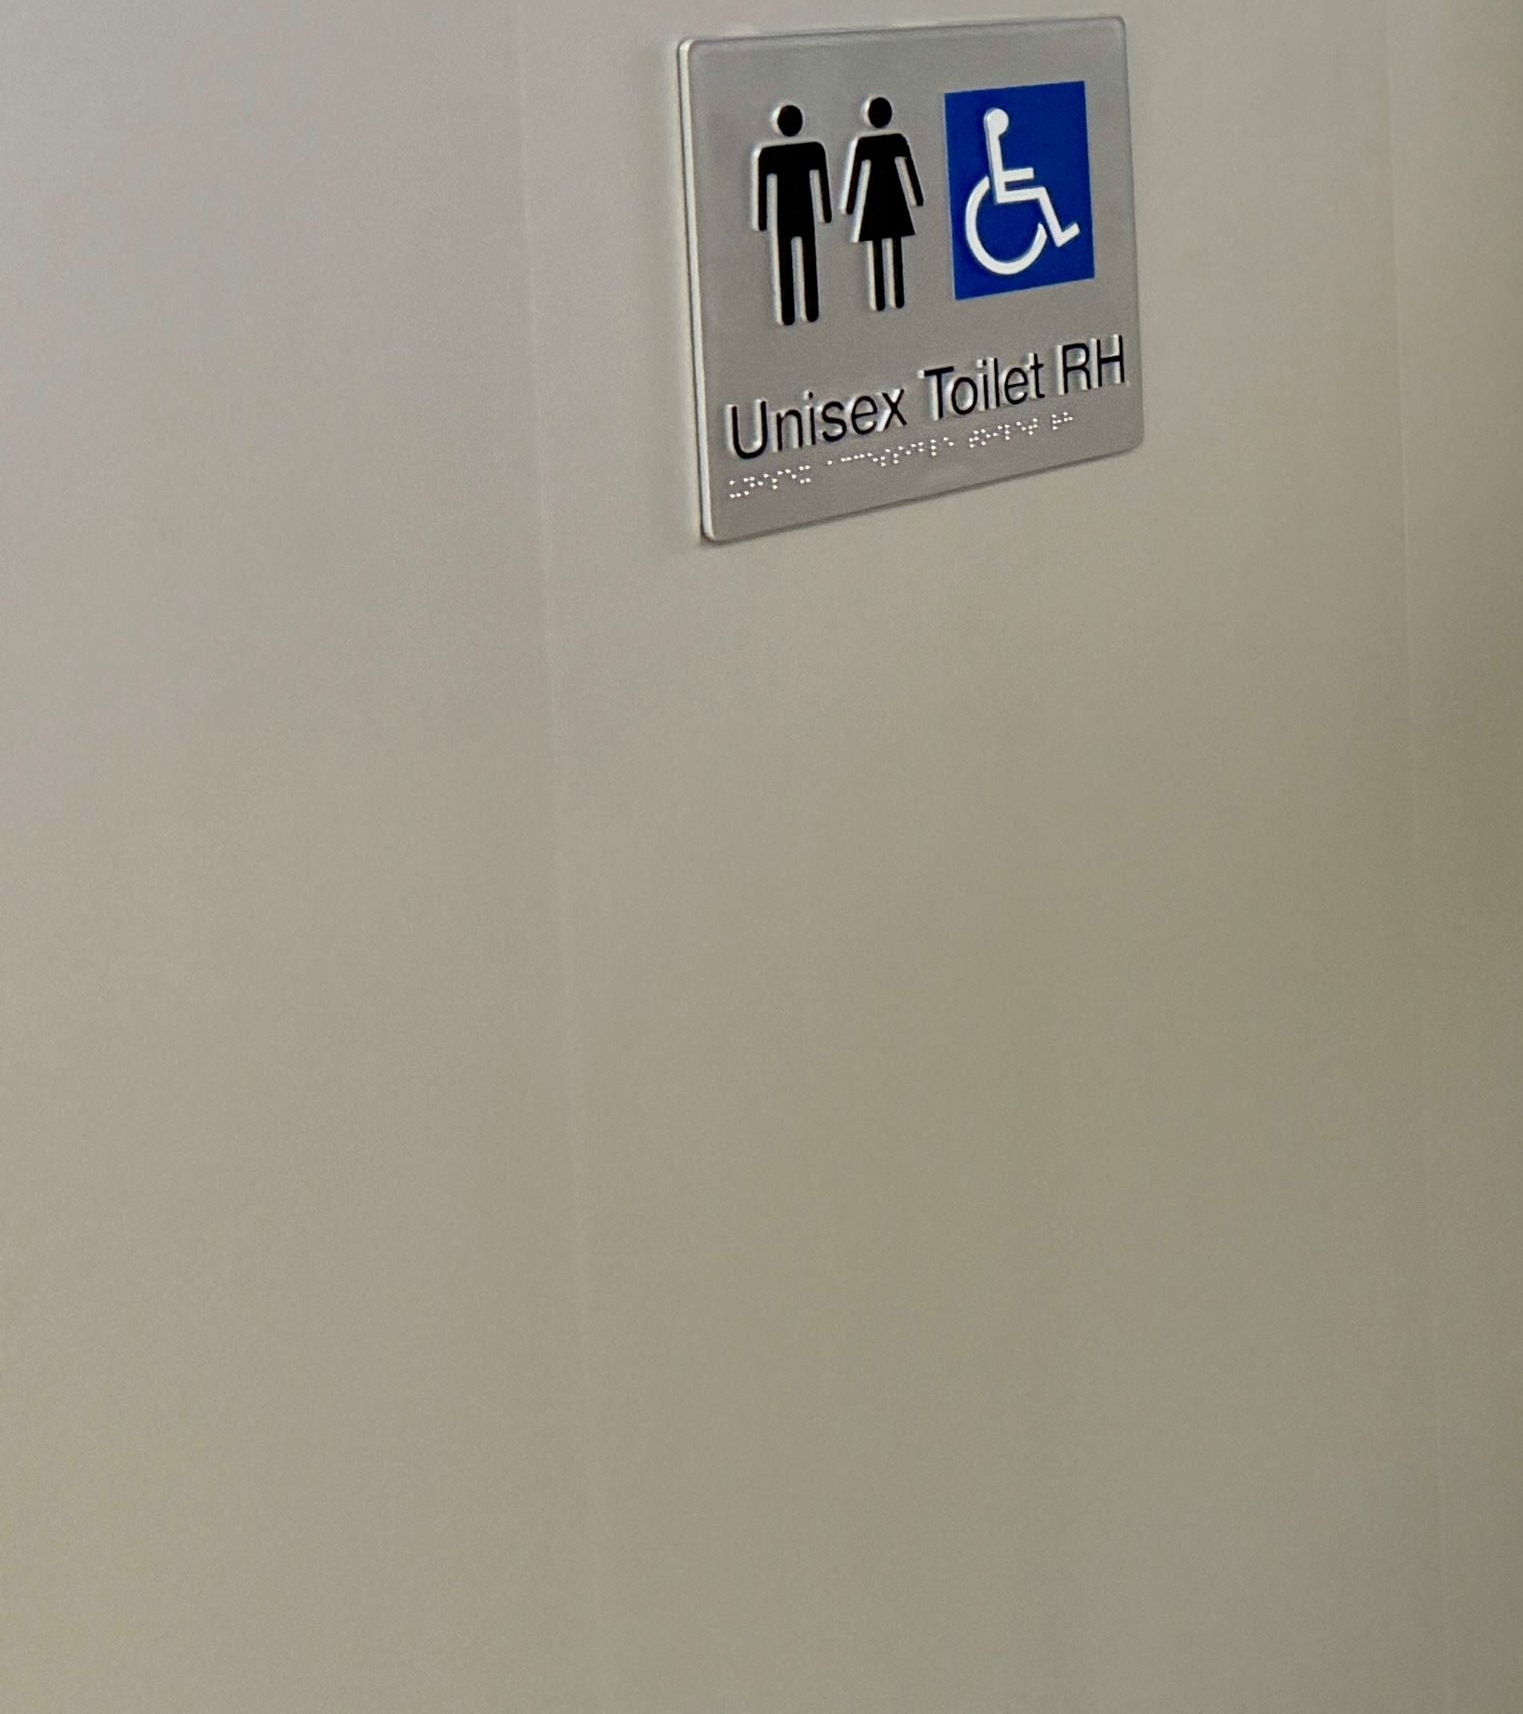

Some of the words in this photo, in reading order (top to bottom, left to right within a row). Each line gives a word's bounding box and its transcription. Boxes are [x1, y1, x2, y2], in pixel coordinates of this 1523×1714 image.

[727, 388, 907, 459] Unisex
[919, 352, 1045, 420] Toilet
[1057, 334, 1125, 395] RH
